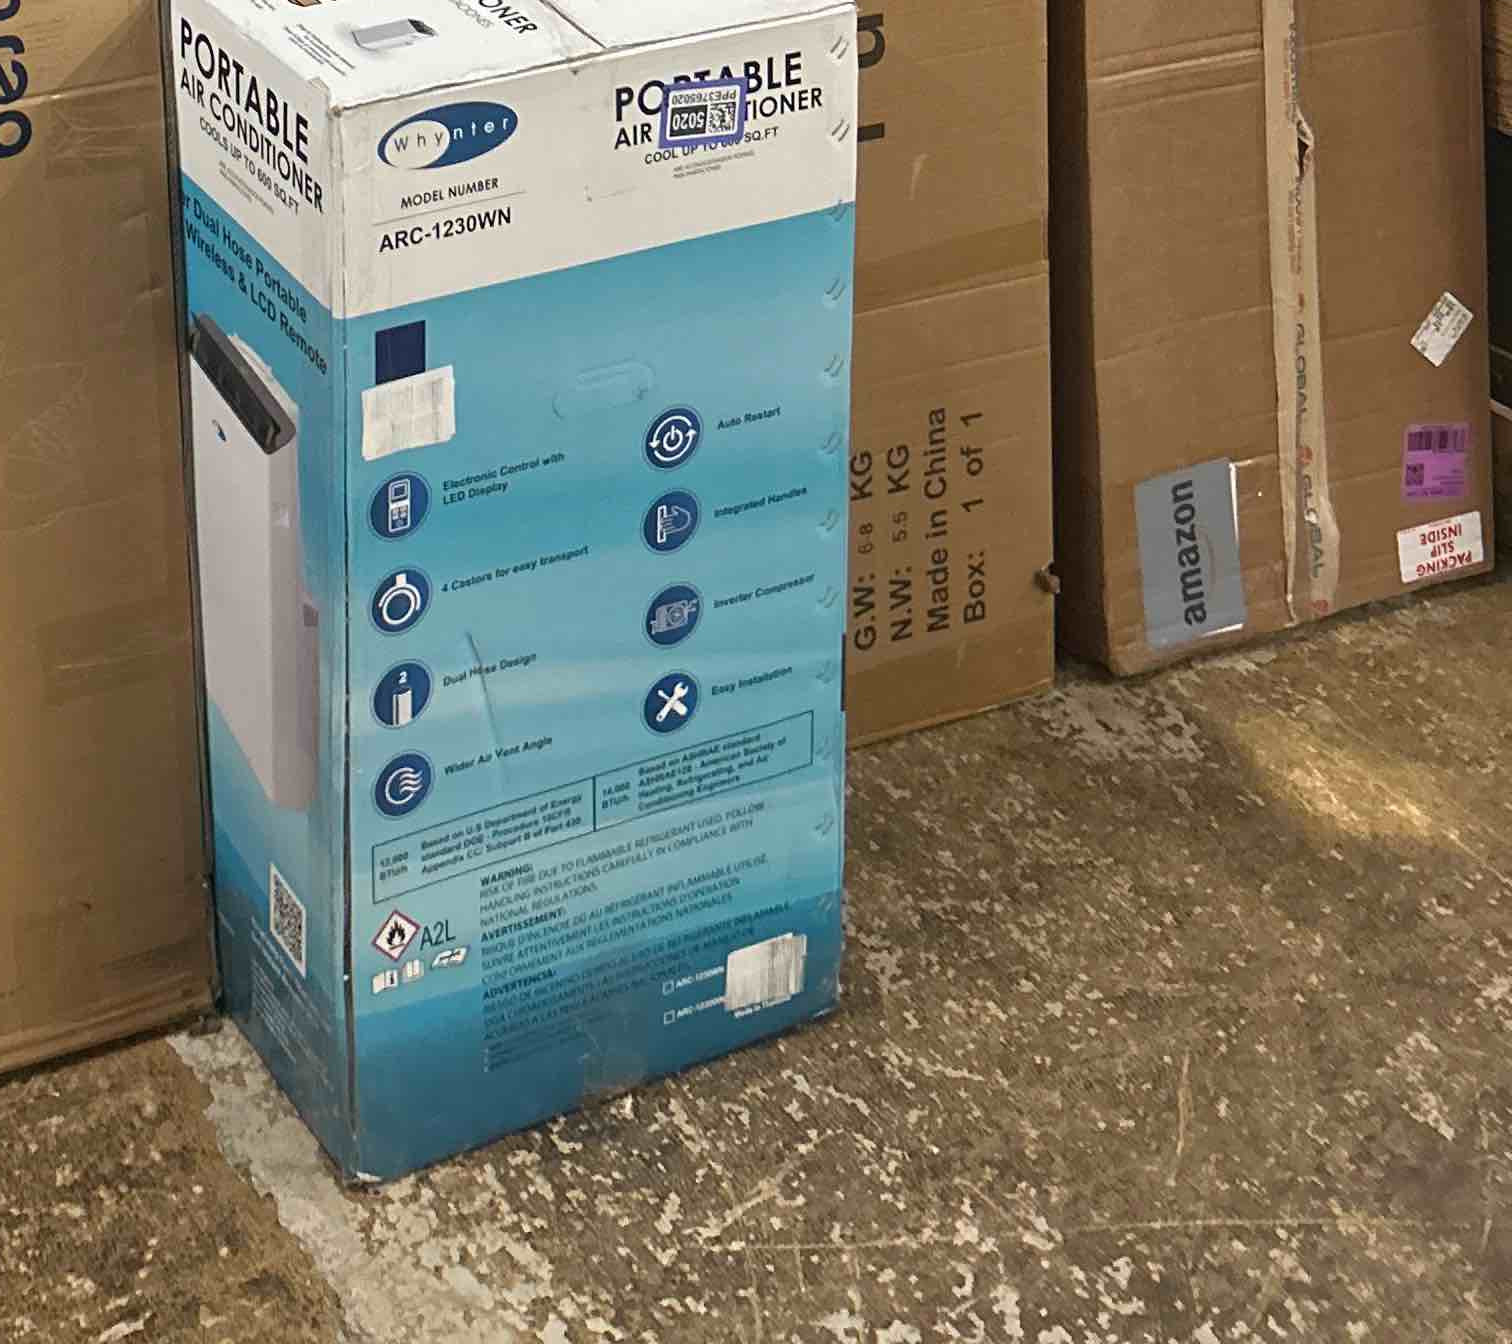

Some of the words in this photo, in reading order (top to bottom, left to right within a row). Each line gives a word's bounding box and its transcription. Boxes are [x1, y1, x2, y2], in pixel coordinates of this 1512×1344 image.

[181, 17, 309, 166] PORTABLE
[615, 51, 803, 122] POBLE
[672, 89, 737, 105] PPE3765020
[614, 122, 652, 150] AIR
[672, 110, 705, 130] 5020
[181, 67, 205, 108] AIR
[209, 92, 323, 214] CONDITIONER
[200, 117, 228, 152] COOLS
[230, 143, 242, 161] UP
[244, 155, 256, 176] TO
[644, 149, 679, 165] COOL
[744, 126, 780, 142] SQ.FT
[400, 191, 444, 209] MODEL
[448, 177, 499, 199] NUMBER
[379, 206, 512, 253] ARC-1230WN
[194, 199, 221, 239] Dual
[223, 229, 253, 269] Hose
[256, 257, 307, 324] Portable
[186, 221, 235, 282] Wireless
[238, 272, 248, 295] &
[251, 282, 277, 322] LCD
[280, 313, 328, 376] Remote
[718, 417, 742, 430] Auto
[744, 407, 781, 422] Restart
[960, 411, 983, 428] 1
[443, 469, 497, 491] Electronic
[500, 457, 540, 476] Control
[542, 452, 566, 466] with
[886, 444, 911, 495] KG
[923, 407, 947, 500] China
[960, 447, 984, 477] of
[443, 492, 465, 505] LED
[468, 481, 509, 498] Display
[850, 451, 873, 502] KG
[961, 497, 985, 512] 1
[925, 509, 948, 540] in
[1419, 523, 1463, 546] INSIDE
[441, 584, 448, 592] 4
[451, 572, 492, 590] Castors
[495, 567, 509, 578] for
[512, 559, 537, 574] easy
[540, 545, 589, 565] transport
[1171, 479, 1207, 627] amazon
[1415, 550, 1473, 577] PACKING
[1430, 541, 1455, 559] SLIP
[755, 573, 815, 598] Compressor
[889, 566, 913, 642] N.W:
[925, 548, 950, 633] Made
[963, 550, 985, 625] Box:
[853, 572, 877, 651] G.W:
[398, 672, 409, 685] 2
[443, 671, 466, 687] Dual
[500, 653, 537, 670] Design
[712, 683, 736, 696] Easy
[445, 759, 474, 775] Wider
[478, 753, 492, 765] Air
[495, 745, 520, 759] Vent
[523, 736, 553, 752] Angle
[420, 919, 456, 951] A2L
